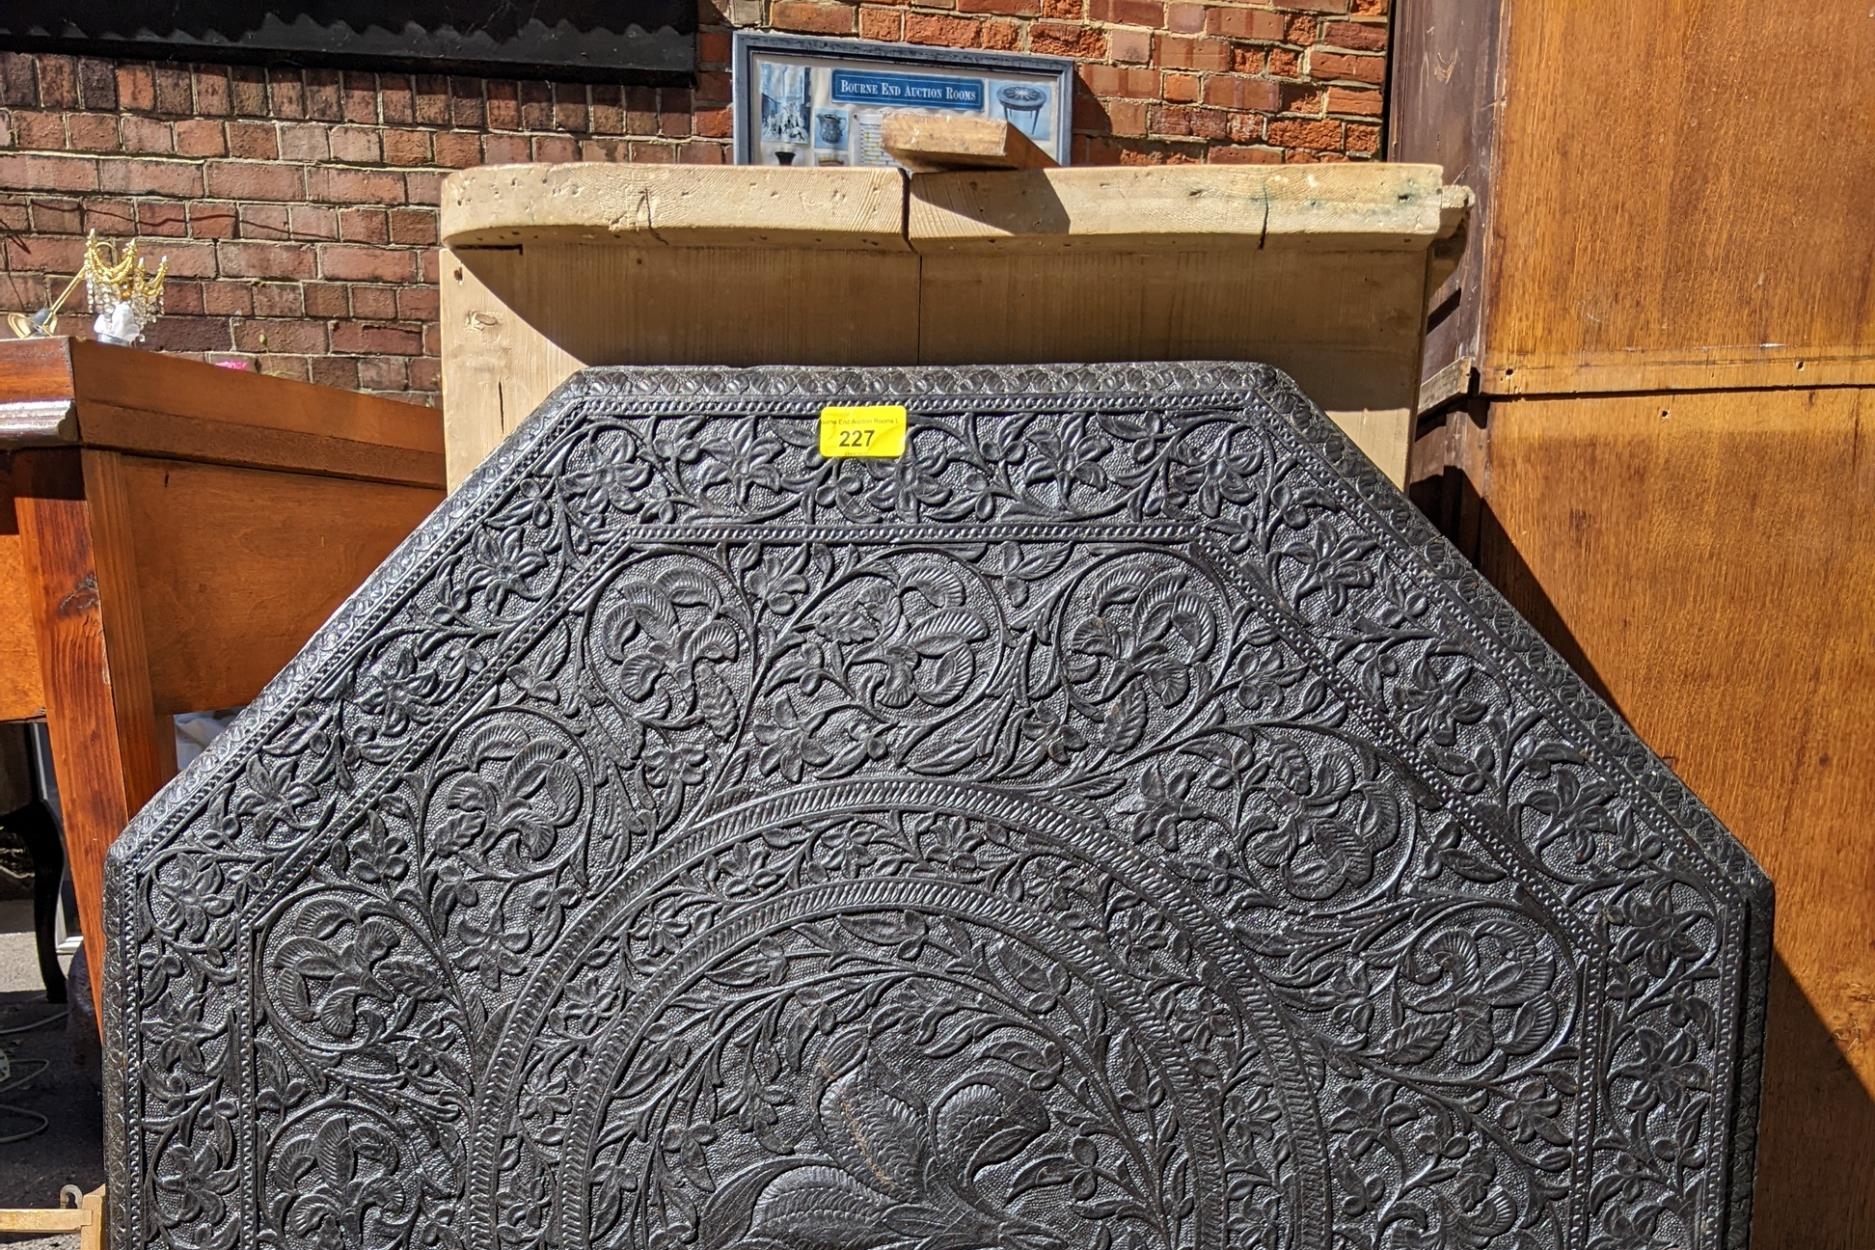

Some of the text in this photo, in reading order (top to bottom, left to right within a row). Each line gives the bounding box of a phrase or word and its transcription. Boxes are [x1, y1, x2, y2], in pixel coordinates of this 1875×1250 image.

[841, 80, 976, 101] BOURNE END AUCTION ROOMS
[839, 430, 875, 448] 227
